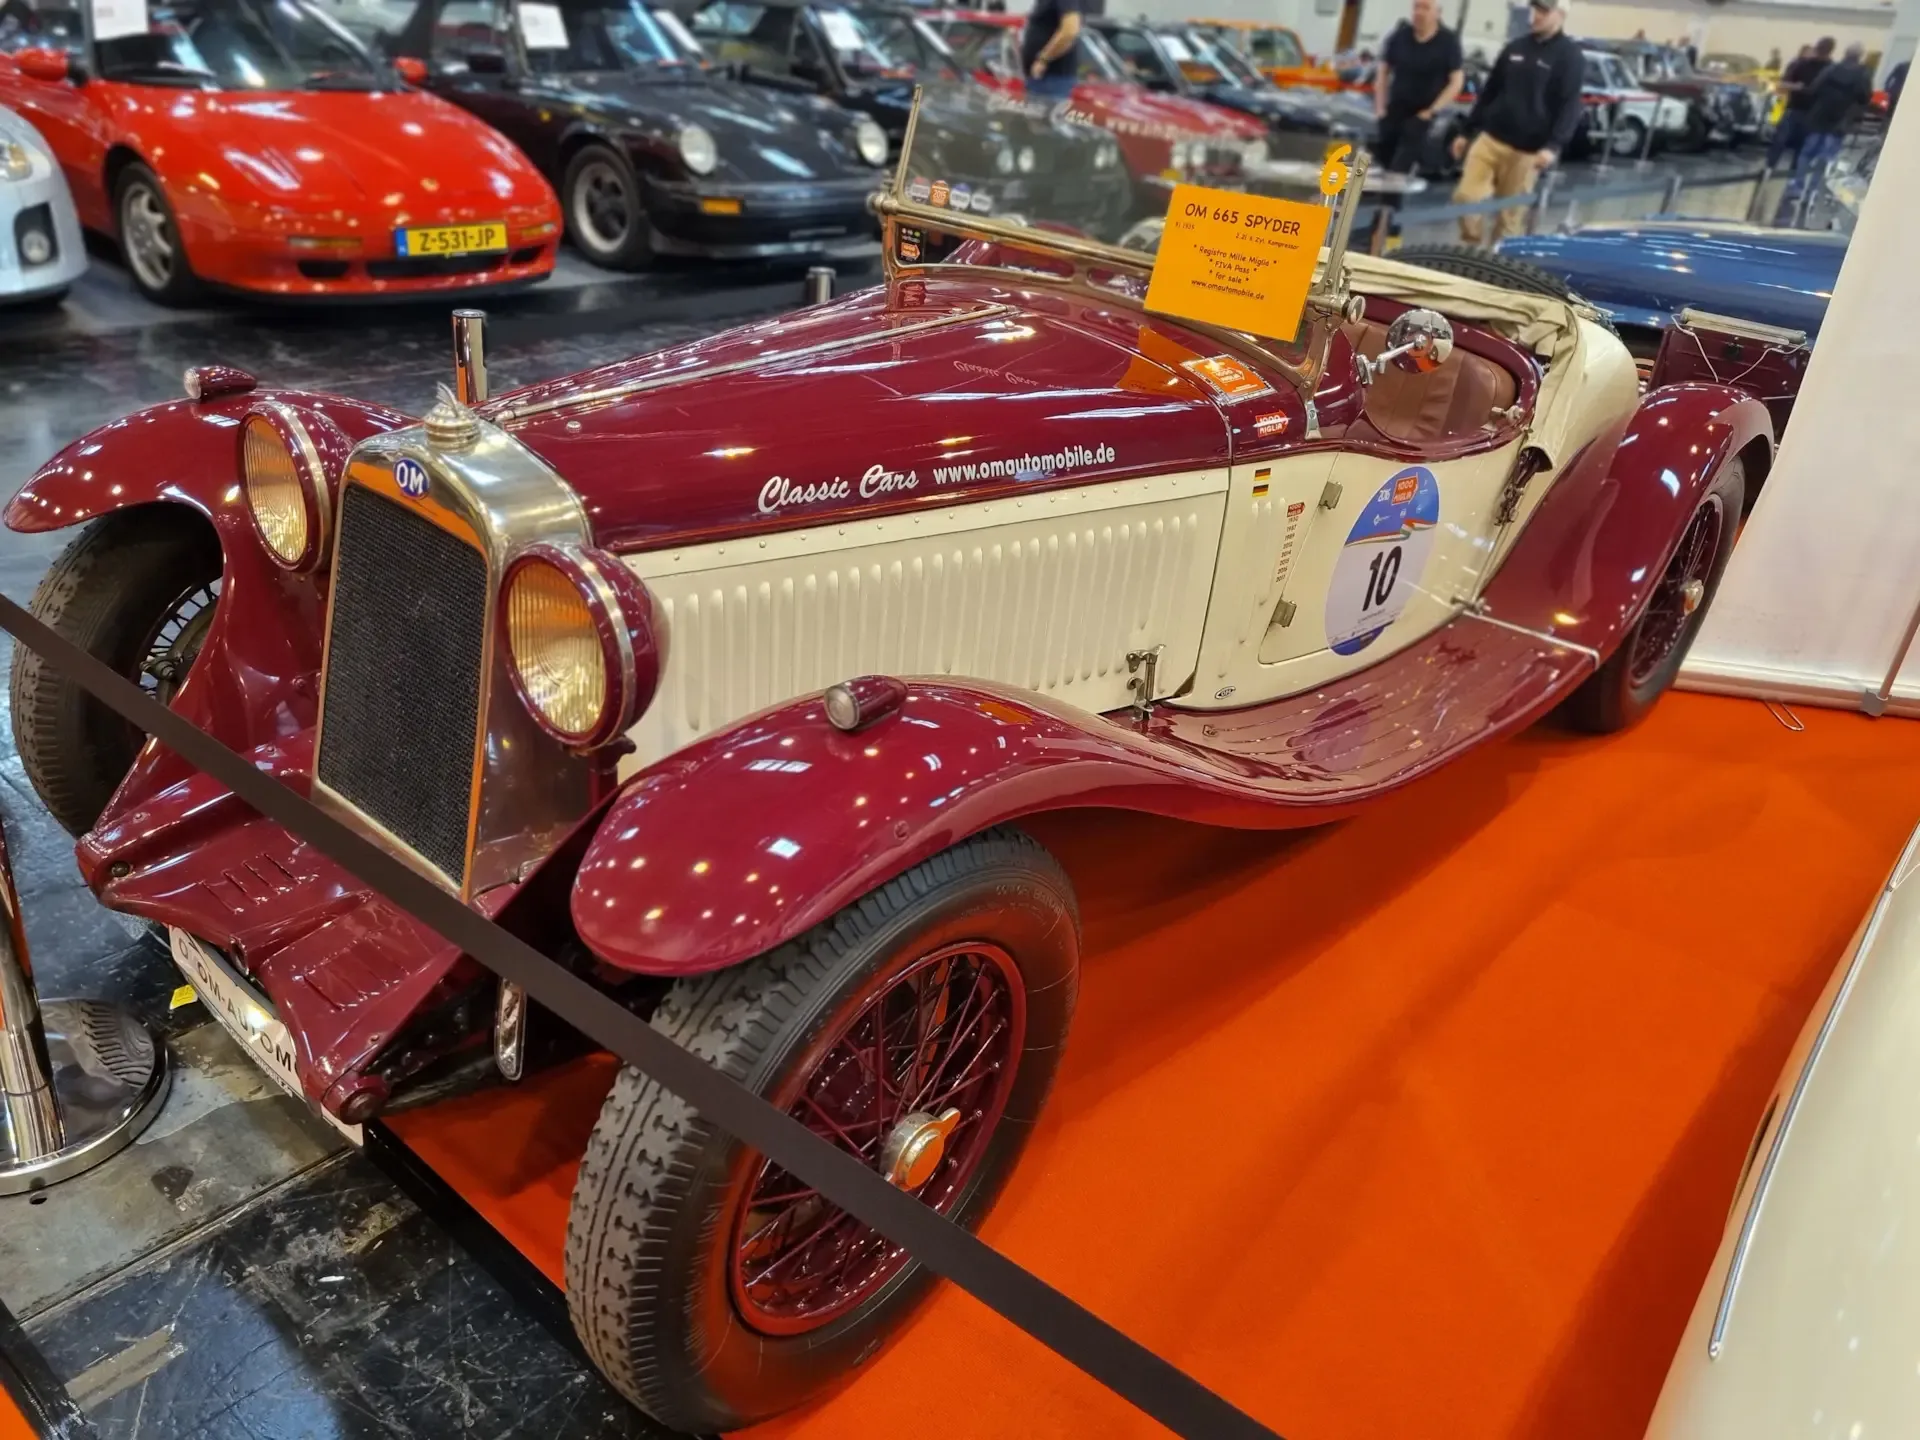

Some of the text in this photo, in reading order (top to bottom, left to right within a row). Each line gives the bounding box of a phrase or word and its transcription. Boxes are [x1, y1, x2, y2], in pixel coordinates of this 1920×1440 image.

[1185, 203, 1300, 236] OM 665 SPYDER
[418, 227, 495, 252] Z-531-JP
[1200, 246, 1269, 267] Registro Mille Miglia
[1215, 261, 1250, 274] FIVA Pass
[1191, 280, 1264, 300] www.omautomobile.de
[1215, 272, 1242, 284] for sale
[396, 462, 424, 494] OM
[758, 442, 1115, 513] Classic Cars www.omautomobile.de
[1362, 545, 1402, 612] 10
